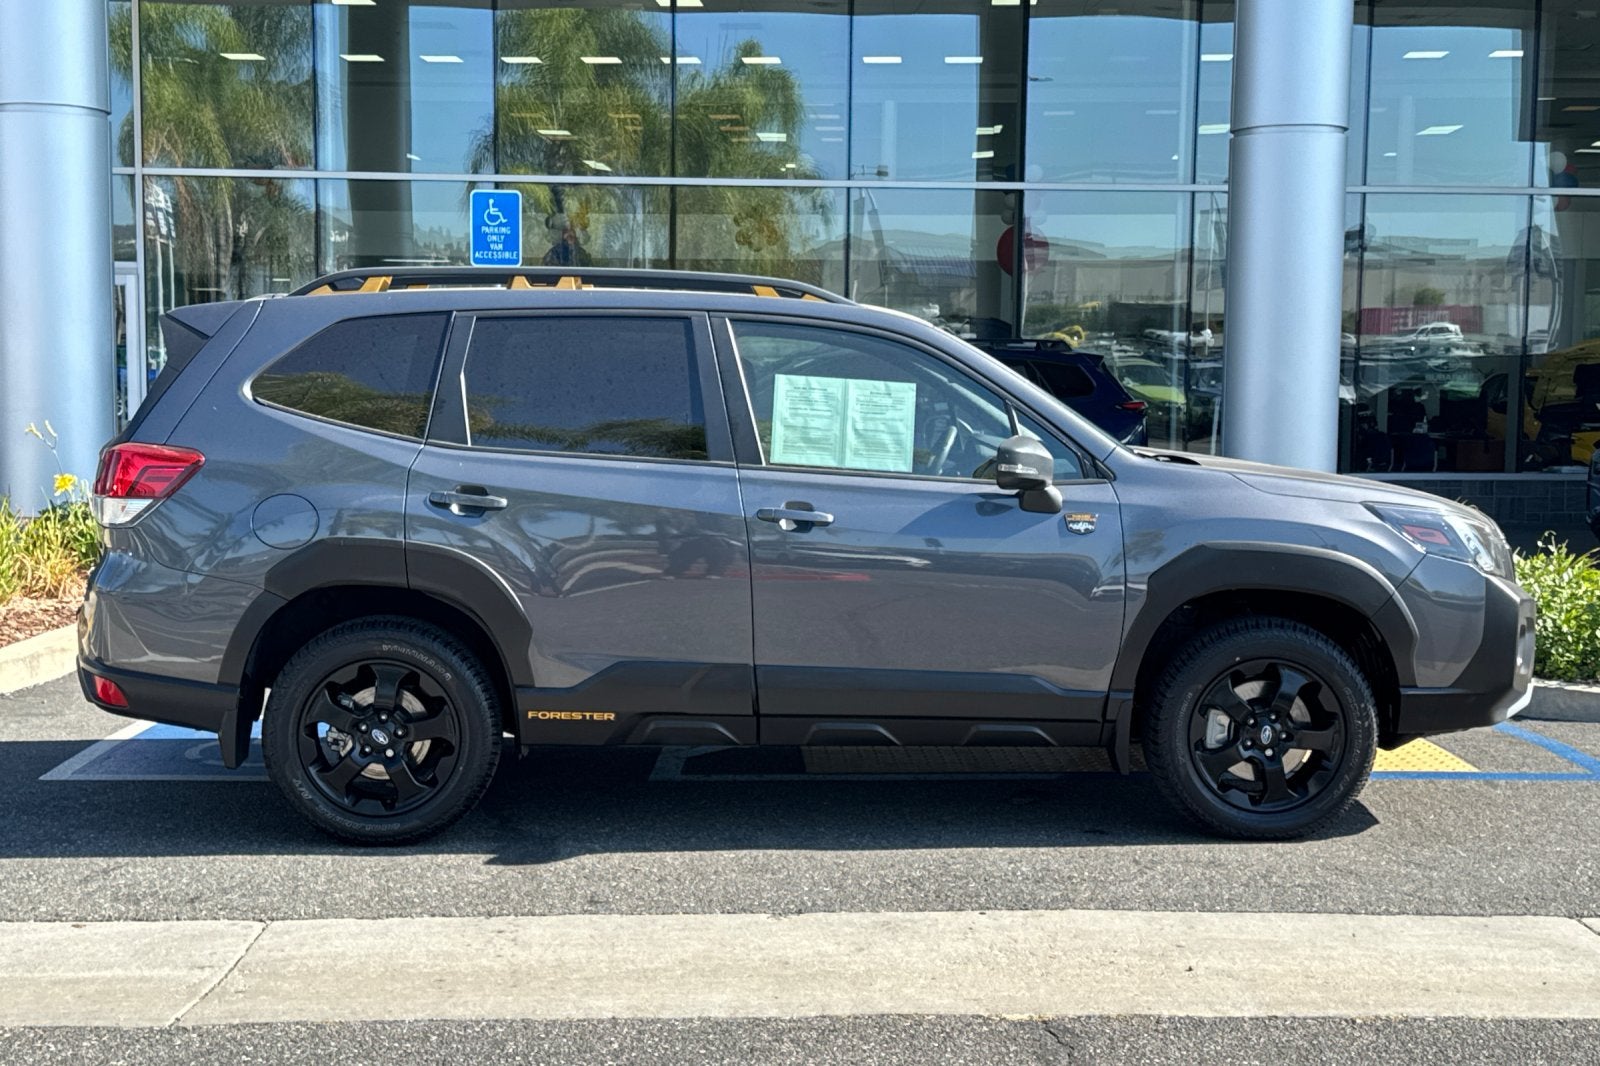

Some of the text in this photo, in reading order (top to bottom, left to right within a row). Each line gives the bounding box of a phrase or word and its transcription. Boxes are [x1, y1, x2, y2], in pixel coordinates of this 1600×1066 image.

[481, 226, 511, 234] PARKING
[475, 251, 518, 259] ACCESSIBLE
[527, 711, 616, 721] FORESTER
